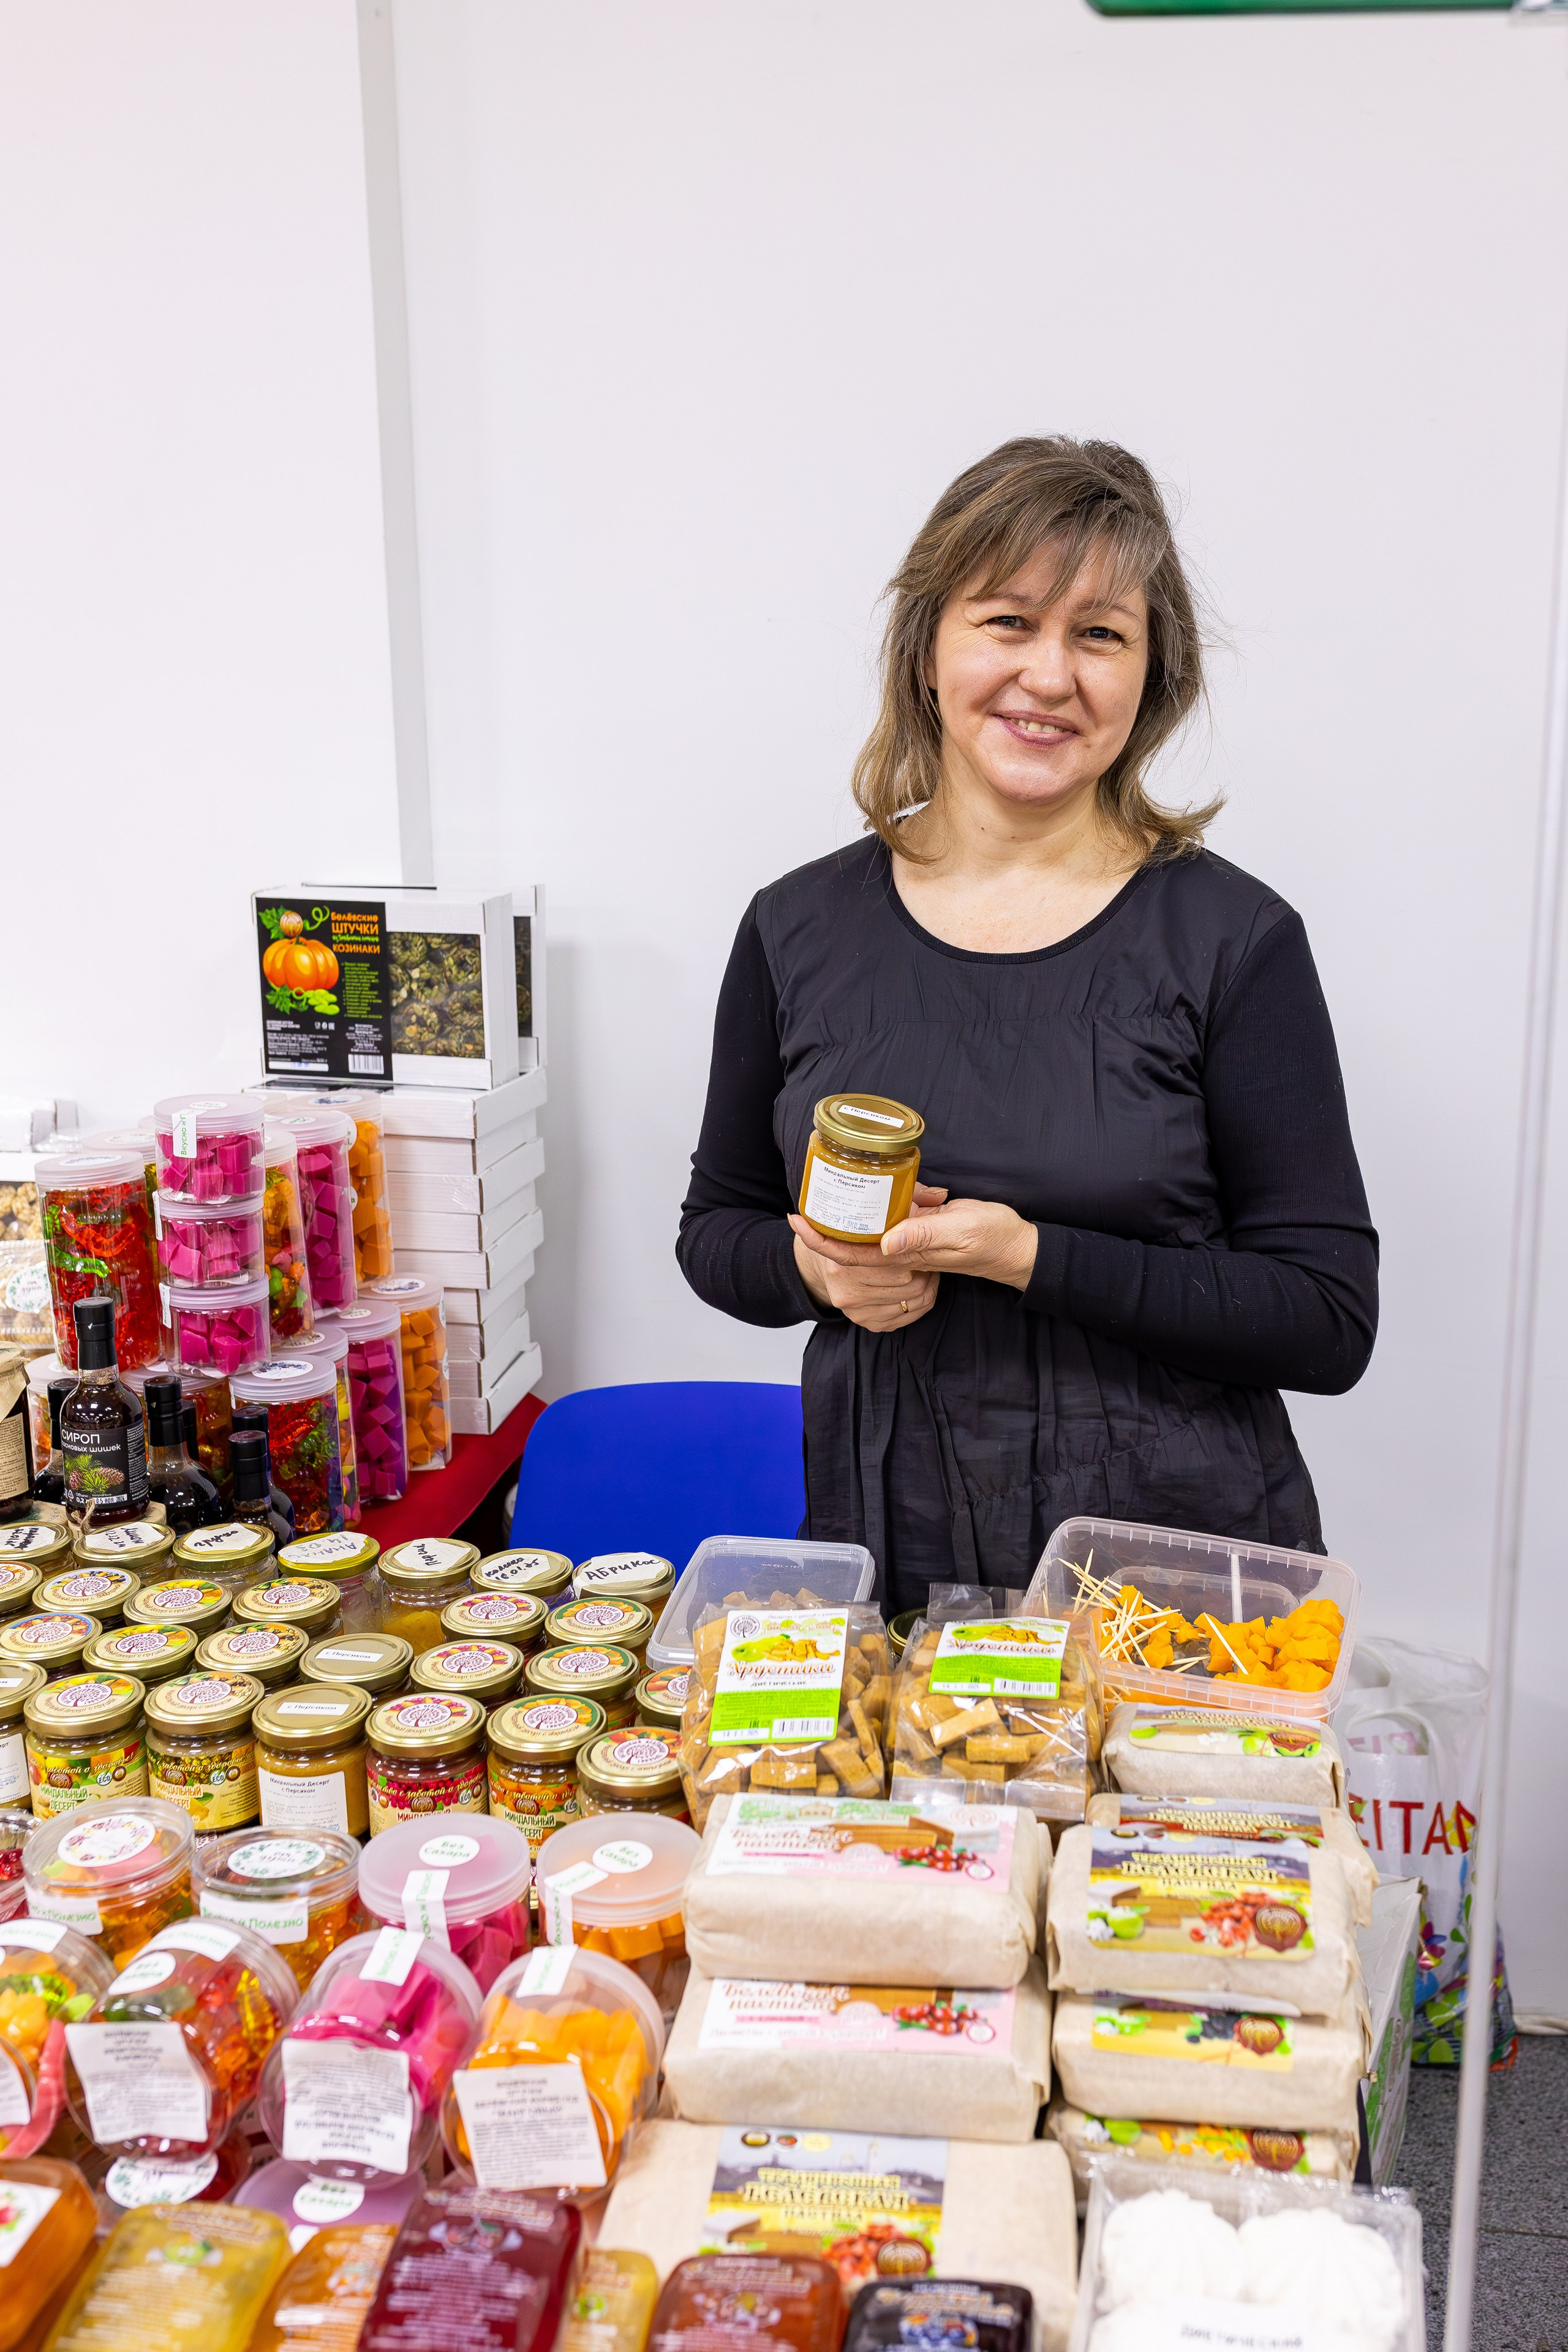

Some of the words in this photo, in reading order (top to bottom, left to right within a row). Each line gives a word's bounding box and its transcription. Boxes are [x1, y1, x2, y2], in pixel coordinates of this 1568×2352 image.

[331, 922, 379, 935] ШТУЧКИ
[333, 944, 380, 954] КОЗИНАКИ
[851, 1107, 891, 1121] Персиком
[824, 1166, 858, 1182] Миндальный
[838, 1179, 866, 1189] Персиком
[61, 1429, 100, 1444] СИРОП
[89, 1444, 121, 1453] шишек
[728, 1660, 835, 1681] Хрустики
[156, 1781, 203, 1796] МИНДАЛЬНЫЙ
[270, 1777, 306, 1787] Миндальный
[307, 1778, 331, 1787] Десерт
[40, 1785, 88, 1800] МИНДАЛЬНЫЙ
[406, 1788, 446, 1799] заботой
[50, 1800, 77, 1811] ДЕСЕРТ
[504, 1811, 555, 1826] МИНДАЛЬНЫЙ
[249, 1917, 304, 1929] Полезно
